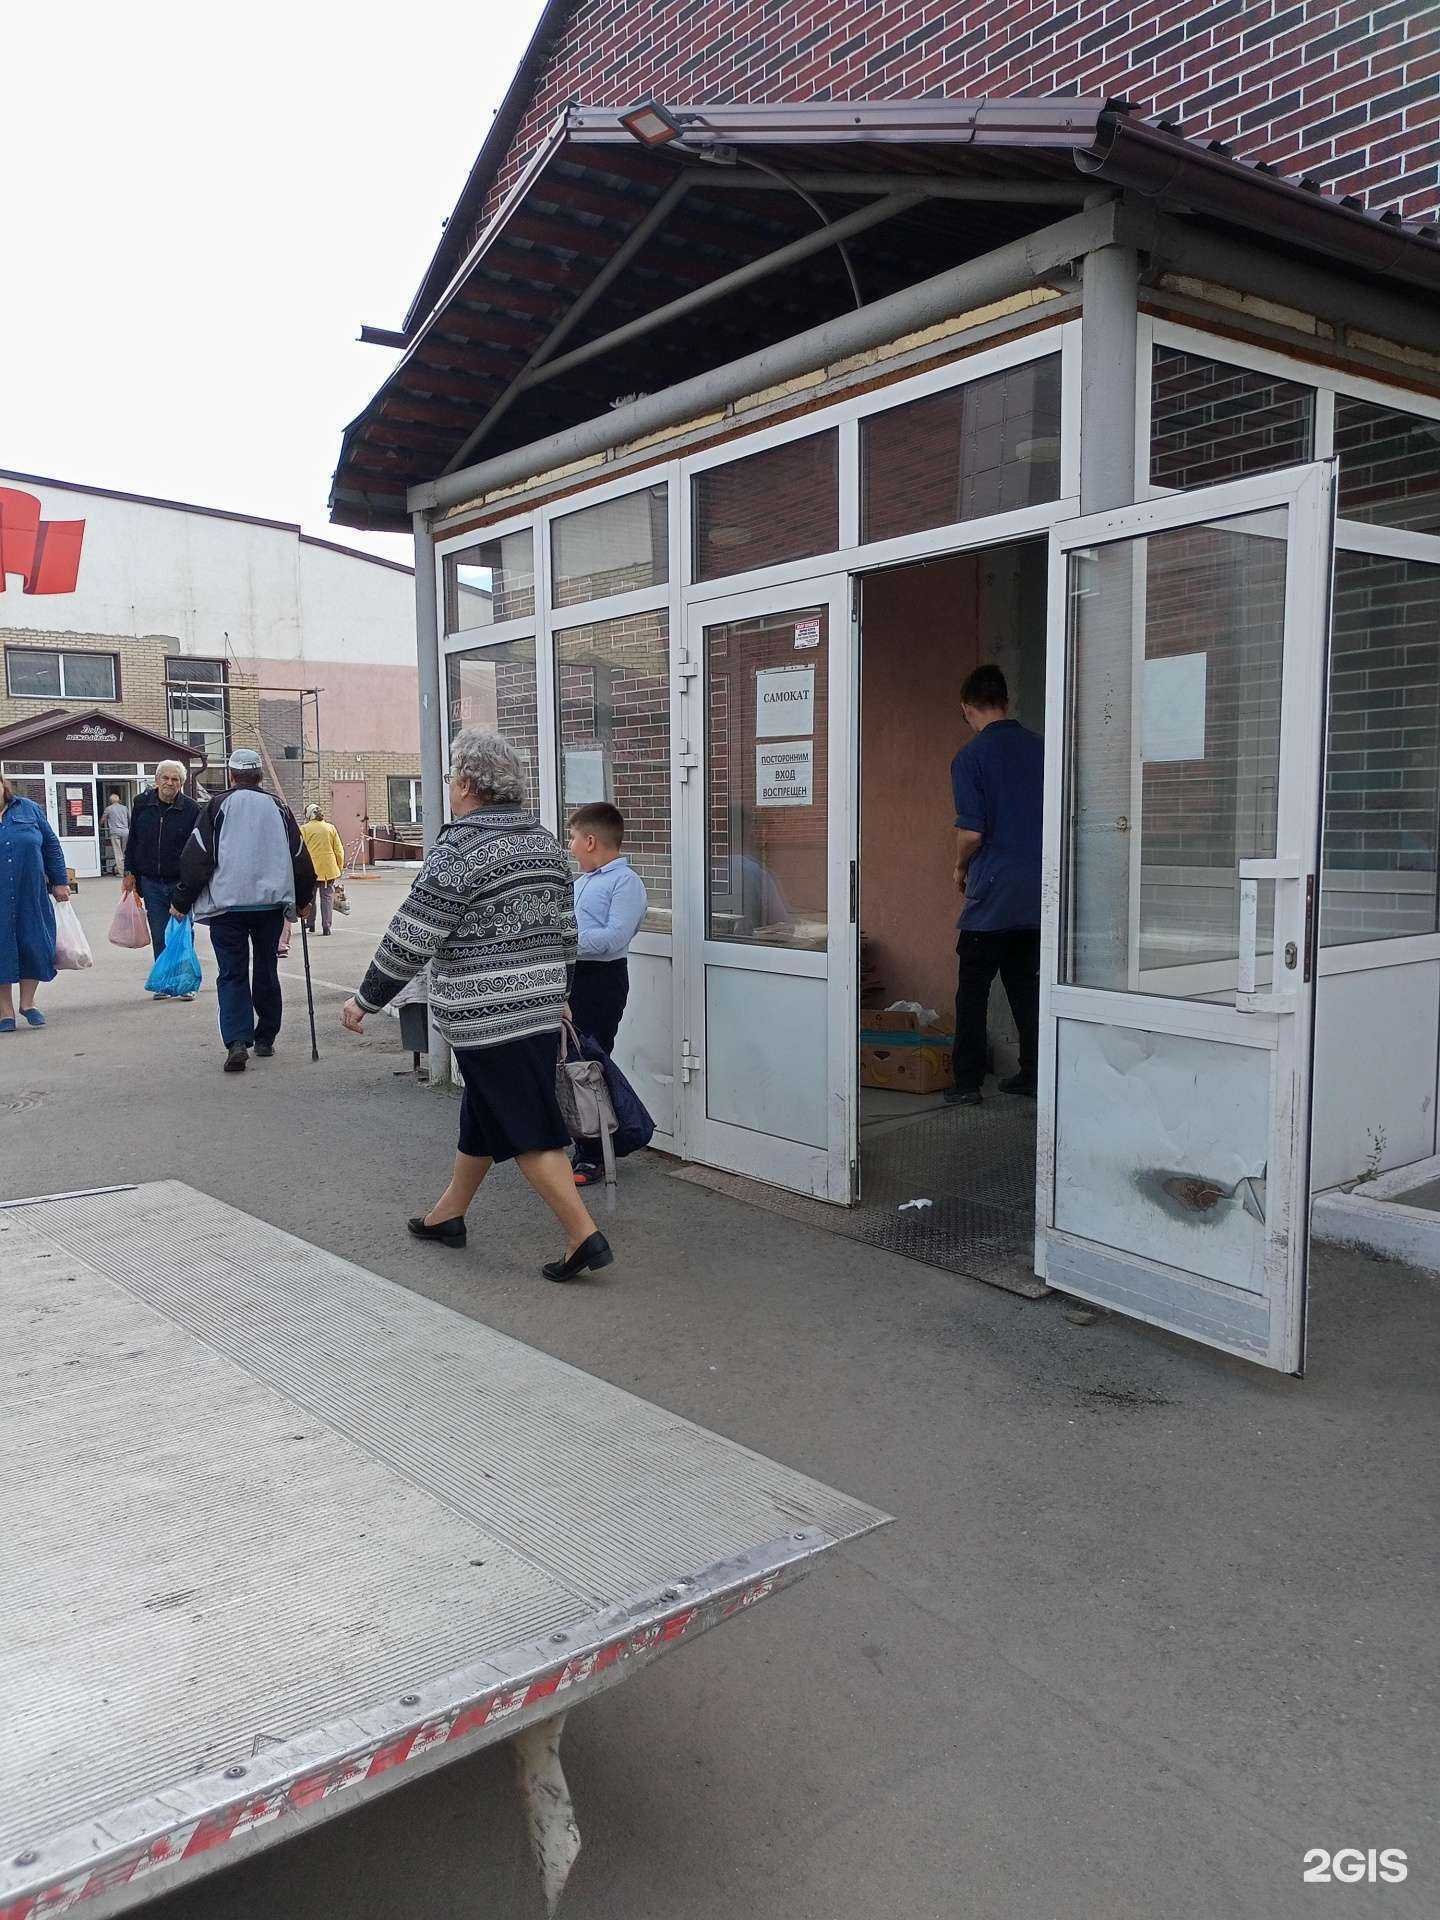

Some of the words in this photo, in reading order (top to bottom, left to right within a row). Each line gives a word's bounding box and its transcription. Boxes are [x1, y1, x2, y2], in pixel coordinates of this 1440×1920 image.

[763, 689, 810, 703] САМОКАТ
[761, 753, 809, 764] ПОСТОРОННИМ
[775, 769, 796, 780] ВХОД
[762, 786, 807, 798] ВОСПРЕЩЕН
